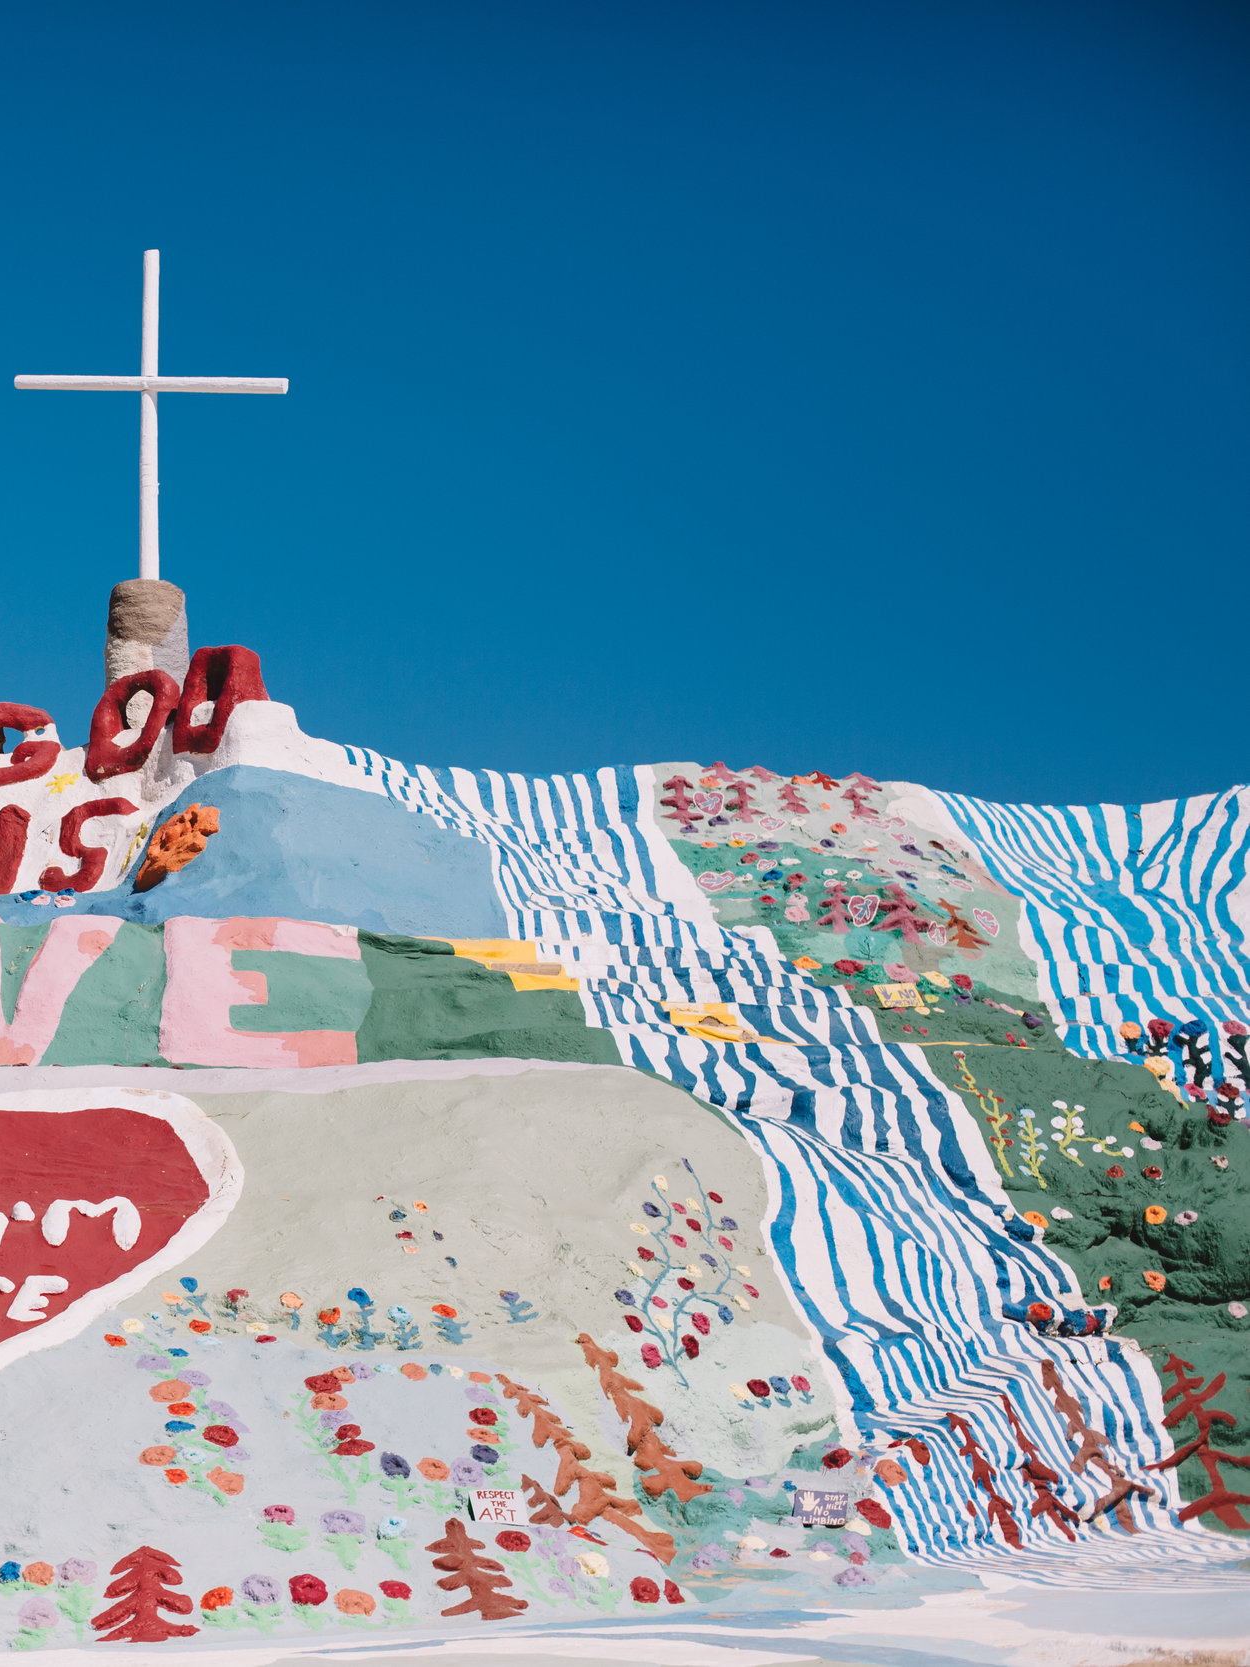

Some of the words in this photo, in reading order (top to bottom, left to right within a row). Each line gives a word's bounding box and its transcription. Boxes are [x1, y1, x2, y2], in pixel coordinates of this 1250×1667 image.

[897, 989, 916, 999] NO
[476, 1490, 514, 1499] RESPECT
[478, 1507, 516, 1521] ART
